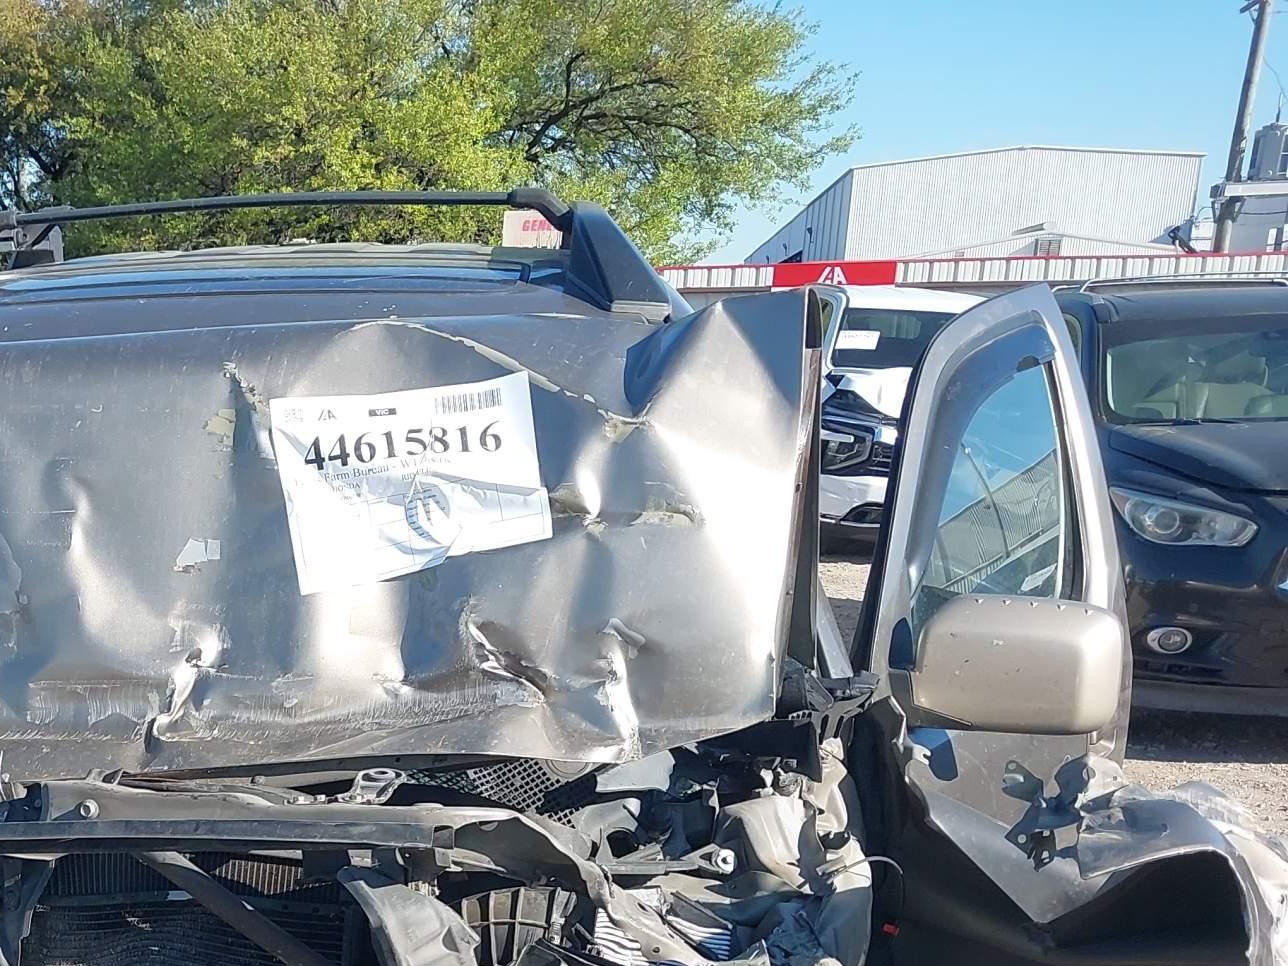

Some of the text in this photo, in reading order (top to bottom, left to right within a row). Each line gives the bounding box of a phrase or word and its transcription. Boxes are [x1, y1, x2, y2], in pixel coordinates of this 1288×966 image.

[304, 421, 502, 470] 44615816
[324, 471, 350, 483] Farm
[353, 464, 389, 478] Bureau
